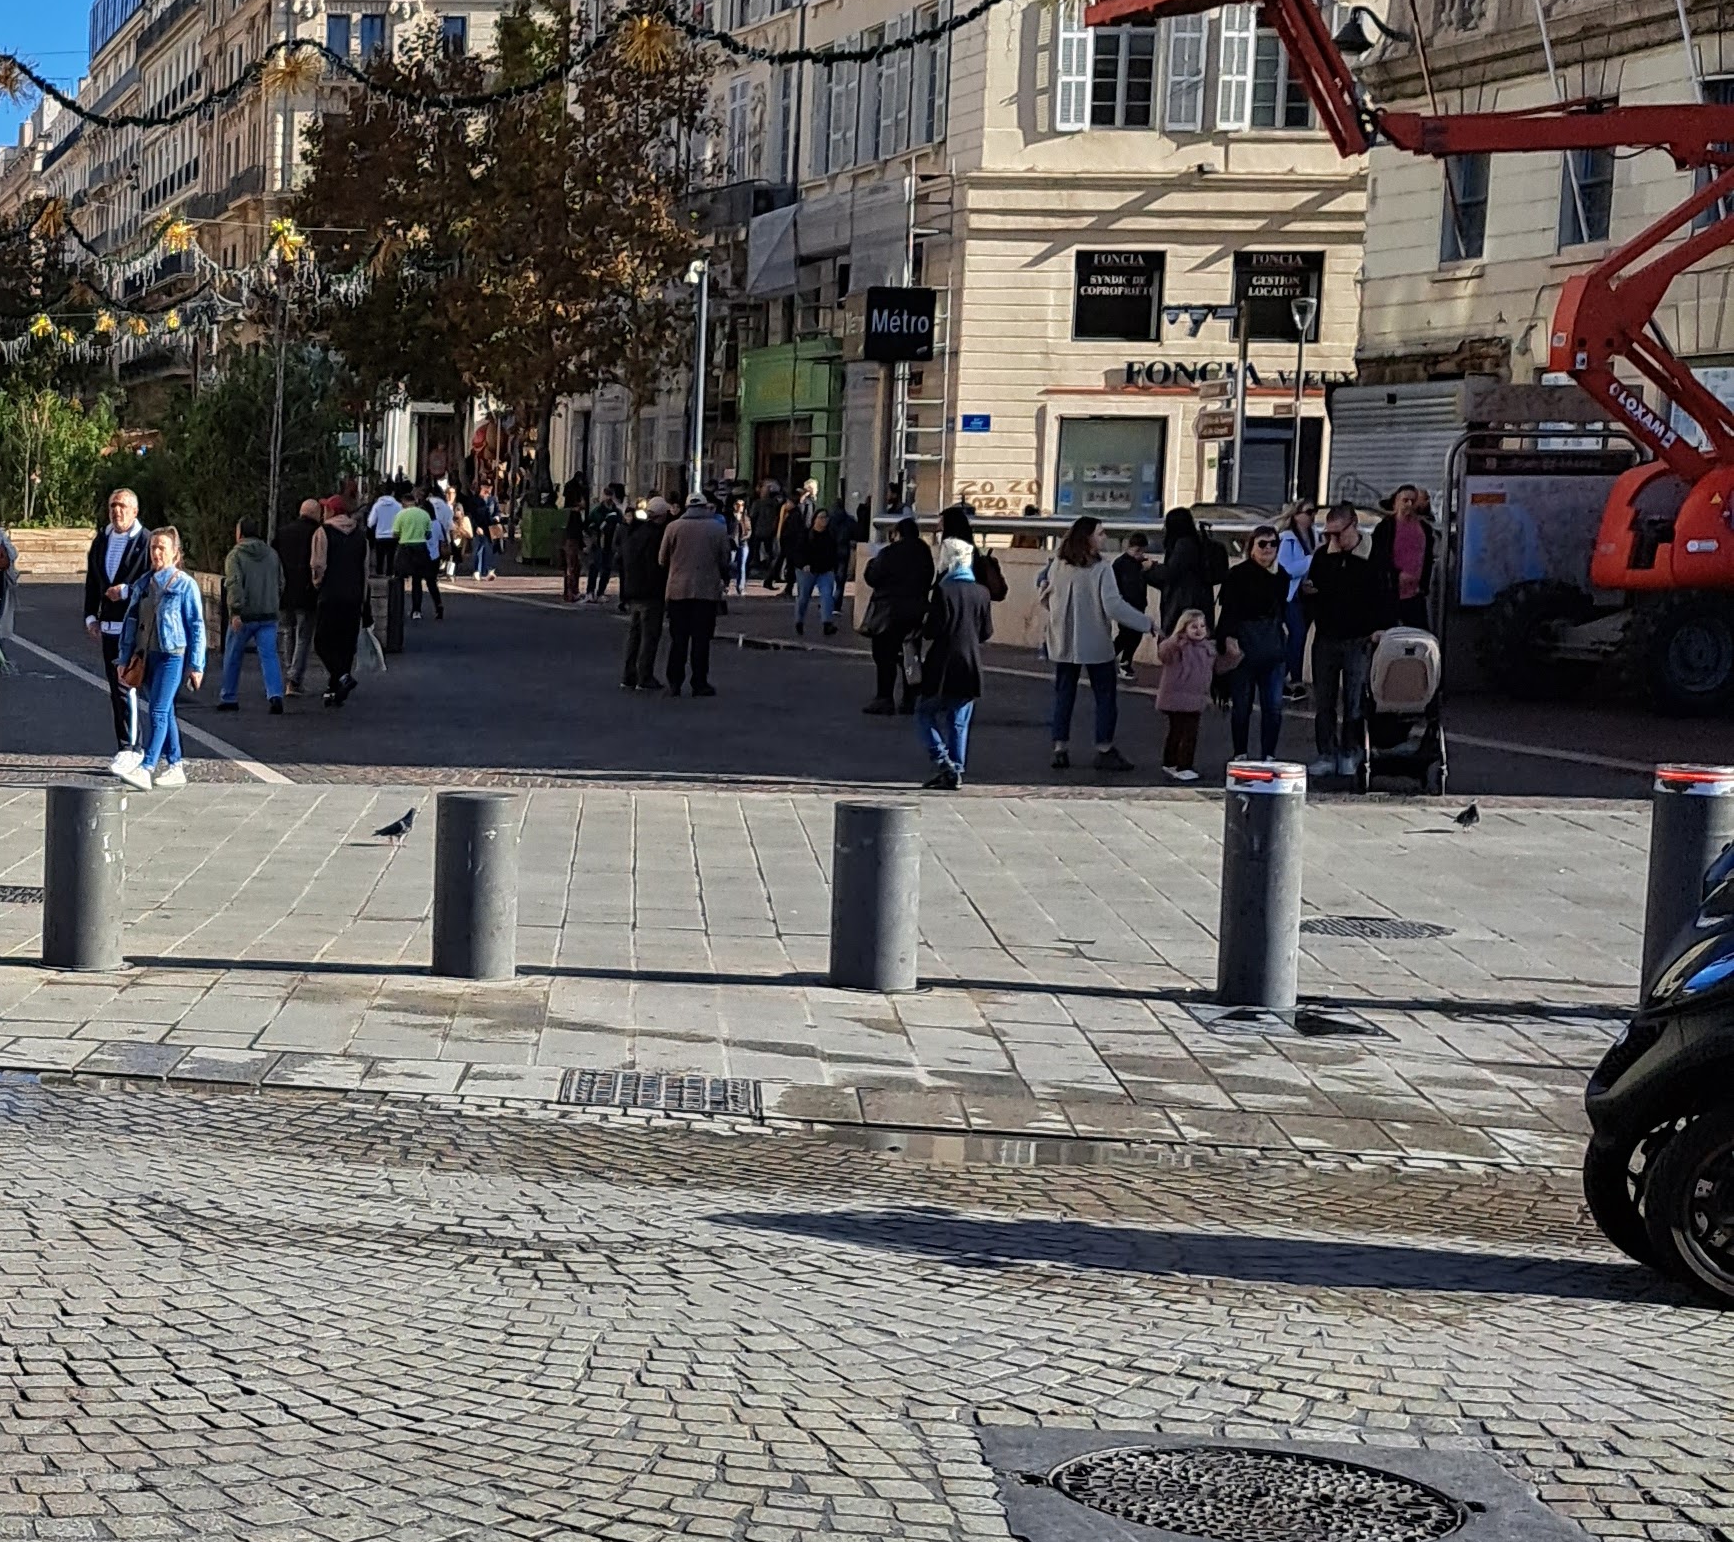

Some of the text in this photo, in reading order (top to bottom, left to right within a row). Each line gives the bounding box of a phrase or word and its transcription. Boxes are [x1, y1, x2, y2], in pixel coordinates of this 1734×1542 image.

[1094, 253, 1146, 266] FONCIA
[1251, 253, 1304, 266] FONCIA
[1089, 274, 1131, 285] SYNDIC
[1251, 275, 1300, 286] GESTION
[871, 308, 930, 334] Métro
[1124, 361, 1262, 386] FONCIA
[1617, 390, 1666, 438] LOXAM
